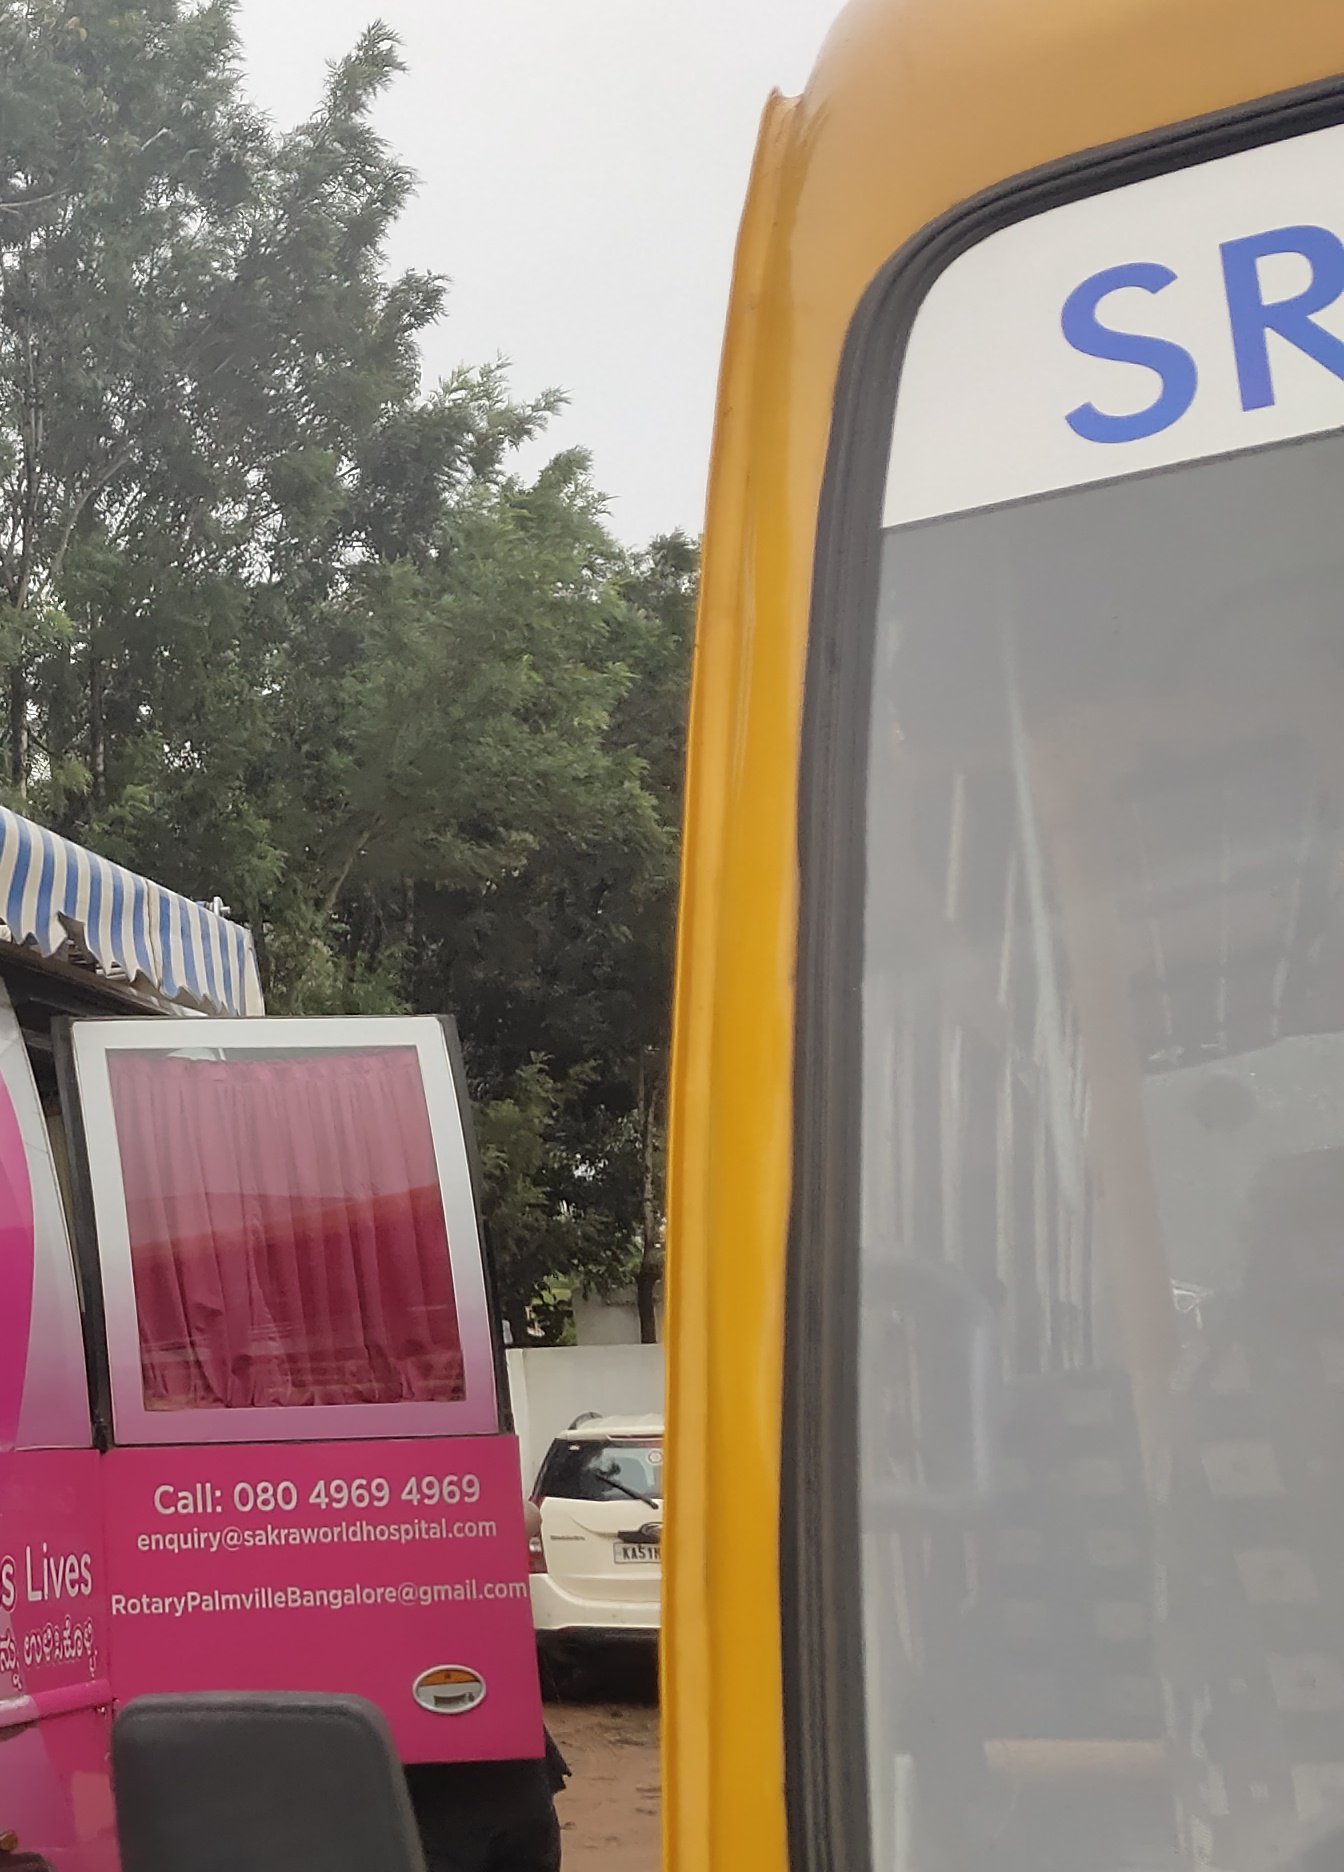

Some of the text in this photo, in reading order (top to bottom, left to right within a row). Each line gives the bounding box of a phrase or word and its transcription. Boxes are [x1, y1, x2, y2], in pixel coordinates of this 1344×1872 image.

[153, 1473, 481, 1515] Call: 080 4969 4969
[137, 1517, 497, 1554] enquiry@sakraworldhospital.com
[25, 1543, 93, 1602] Lives
[111, 1578, 528, 1618] RotaryPalmvilleBangalore@gmail.com
